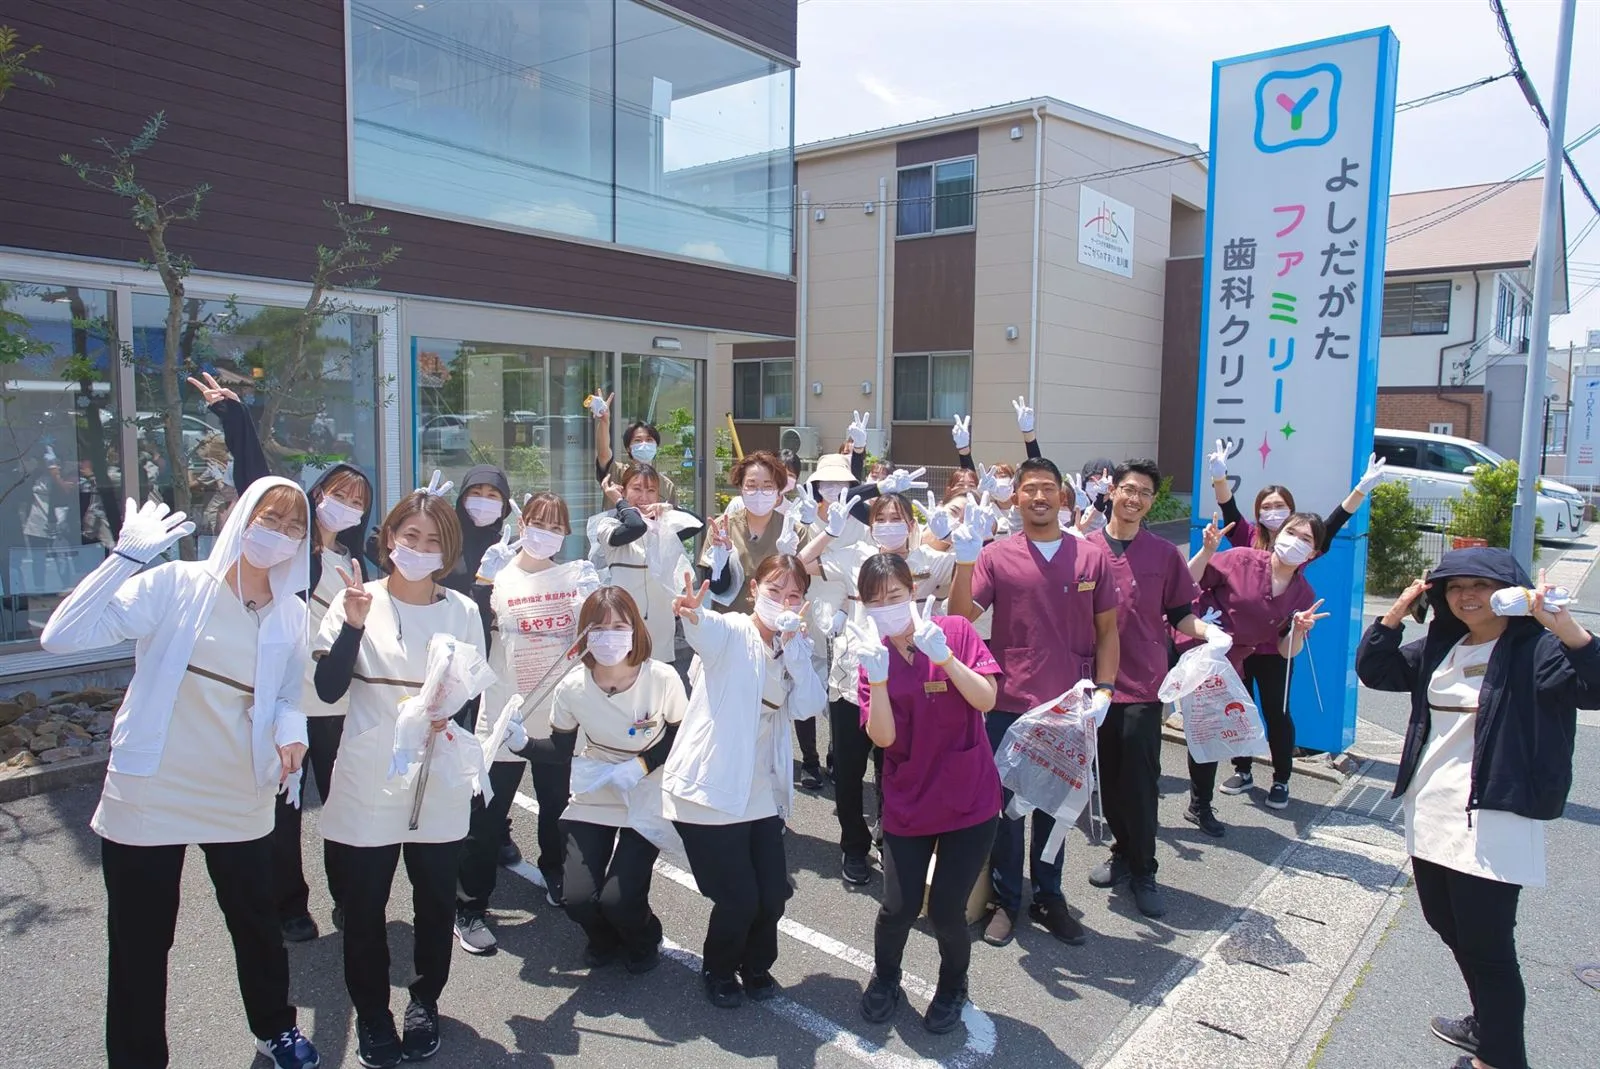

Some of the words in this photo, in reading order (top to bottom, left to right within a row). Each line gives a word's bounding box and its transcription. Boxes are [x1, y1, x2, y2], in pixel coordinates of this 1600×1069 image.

[1268, 204, 1306, 414] ファミリー
[1314, 157, 1360, 360] よしだがた
[1585, 392, 1594, 423] TOKAI
